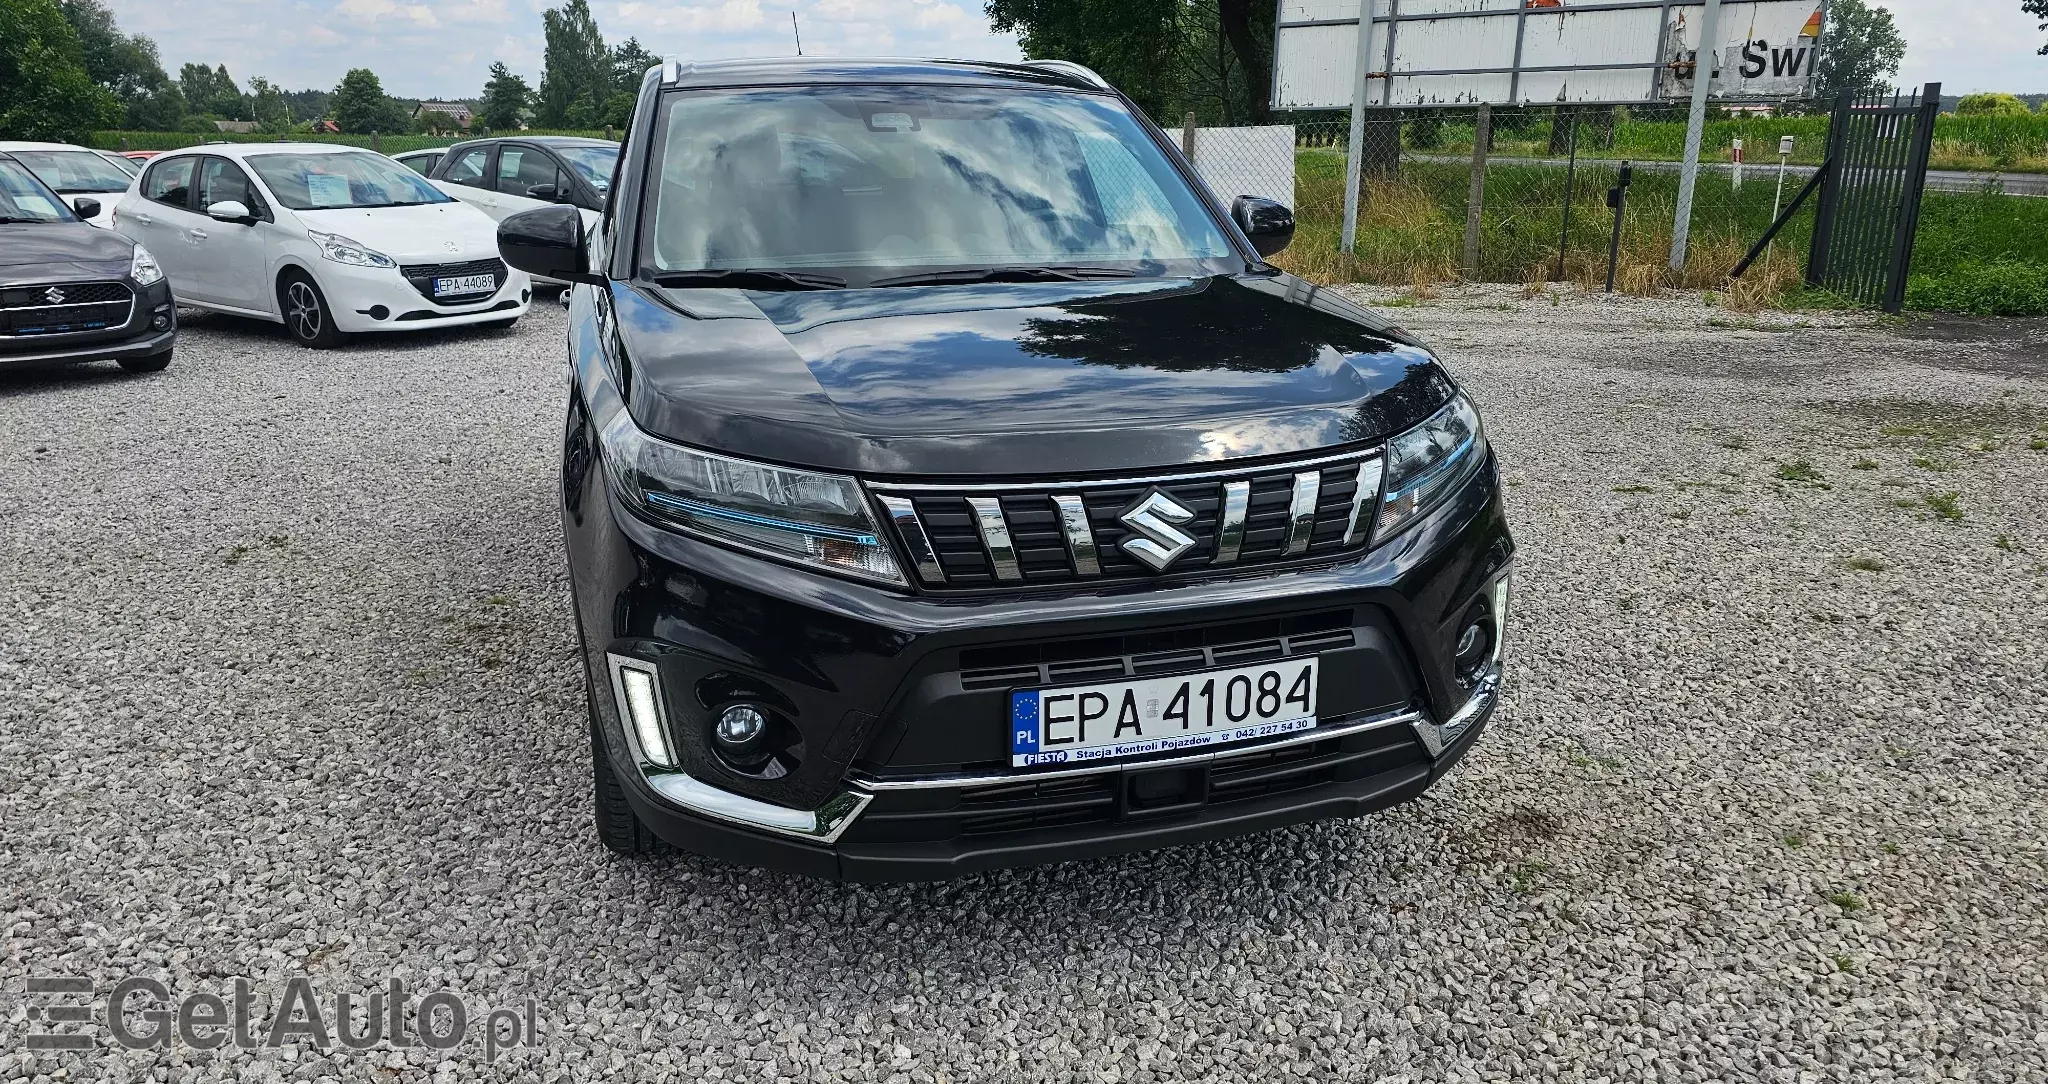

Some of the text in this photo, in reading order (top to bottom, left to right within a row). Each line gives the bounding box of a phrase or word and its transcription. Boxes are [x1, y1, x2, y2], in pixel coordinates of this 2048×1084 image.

[439, 279, 461, 292] EPA
[464, 275, 493, 289] 44089
[1044, 665, 1312, 745] EPA 41084
[1016, 730, 1036, 745] PL
[1076, 748, 1112, 759] Stacja
[1115, 742, 1158, 755] Kontroli
[1161, 736, 1211, 750] Pojazdów
[1260, 725, 1278, 735] 227
[1281, 722, 1293, 731] 54
[1295, 720, 1308, 729] 30
[1027, 752, 1066, 765] FIESTA
